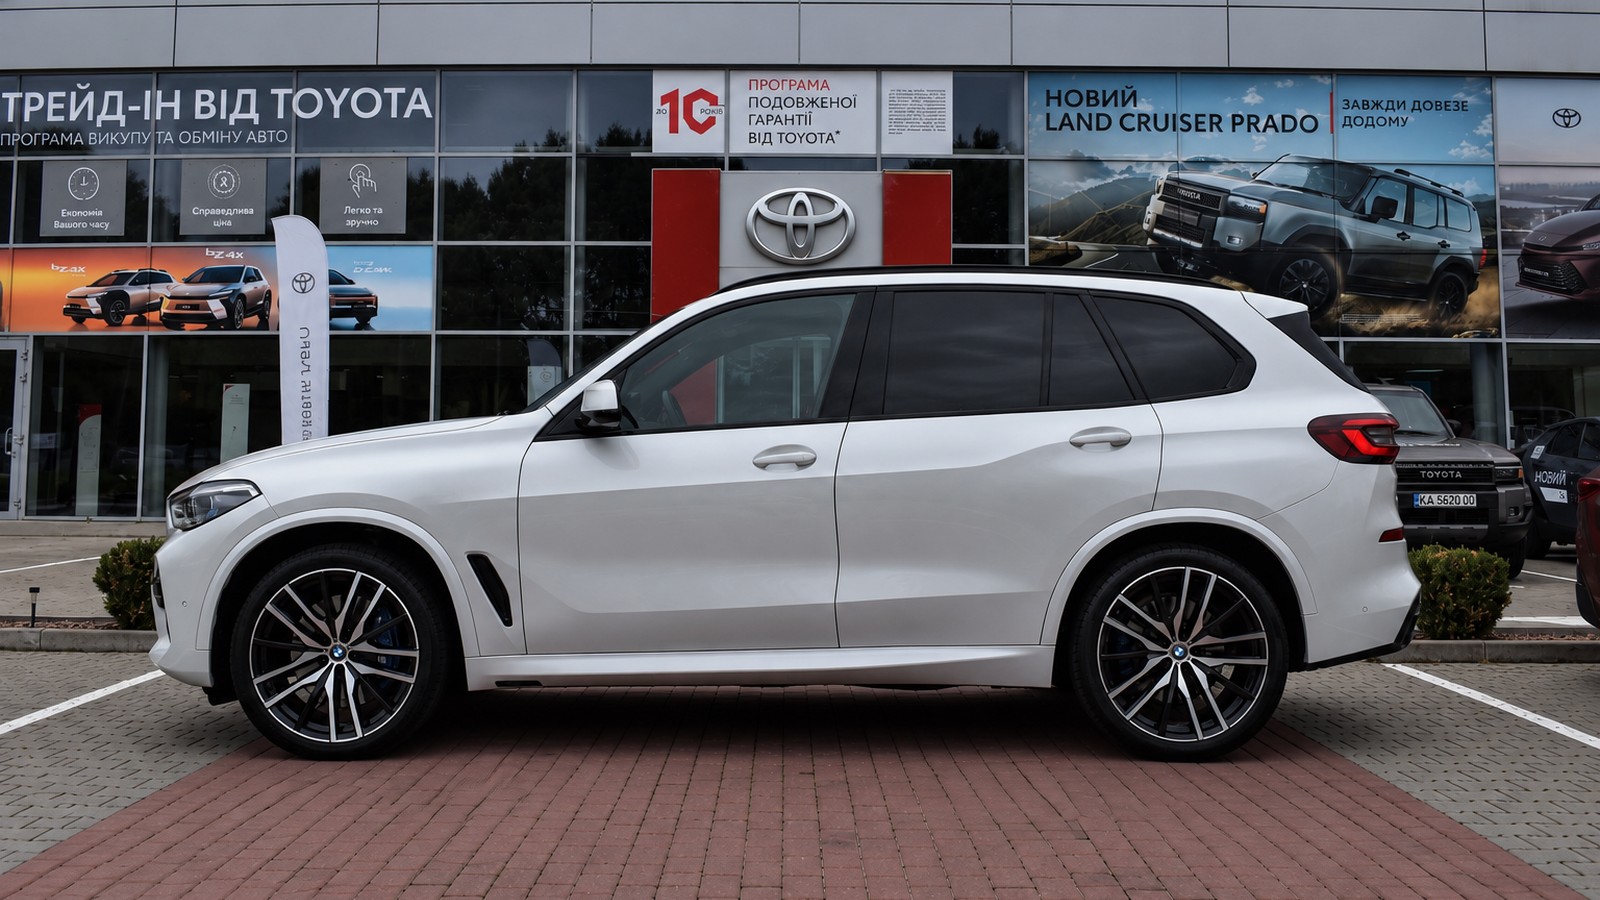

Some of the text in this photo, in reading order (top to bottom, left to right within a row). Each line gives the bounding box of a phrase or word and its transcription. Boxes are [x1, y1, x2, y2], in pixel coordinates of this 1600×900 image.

[748, 79, 830, 91] ПРОГРАМА
[748, 94, 858, 109] ПОДОВЖЕНОЇ
[1046, 86, 1138, 108] НОВИЙ
[2, 82, 433, 127] ТРЕЙД-ІН ВІД TOYOTA
[1342, 99, 1469, 113] ЗАВЖДИ ДОВЕЗЕ
[748, 111, 812, 126] ГАРАНТІЇ
[1046, 112, 1320, 134] LAND CRUISER PRADO
[1342, 116, 1409, 128] ДОДОМУ
[1, 130, 288, 146] ПРОГРАМА ВИКУПУ ТА ОБМІНУ АВТО
[748, 132, 773, 146] ВІД
[54, 220, 110, 231] Вашого часу
[1420, 470, 1462, 478] TOYOTA
[1420, 495, 1434, 506] KA
[1437, 495, 1461, 506] 5620
